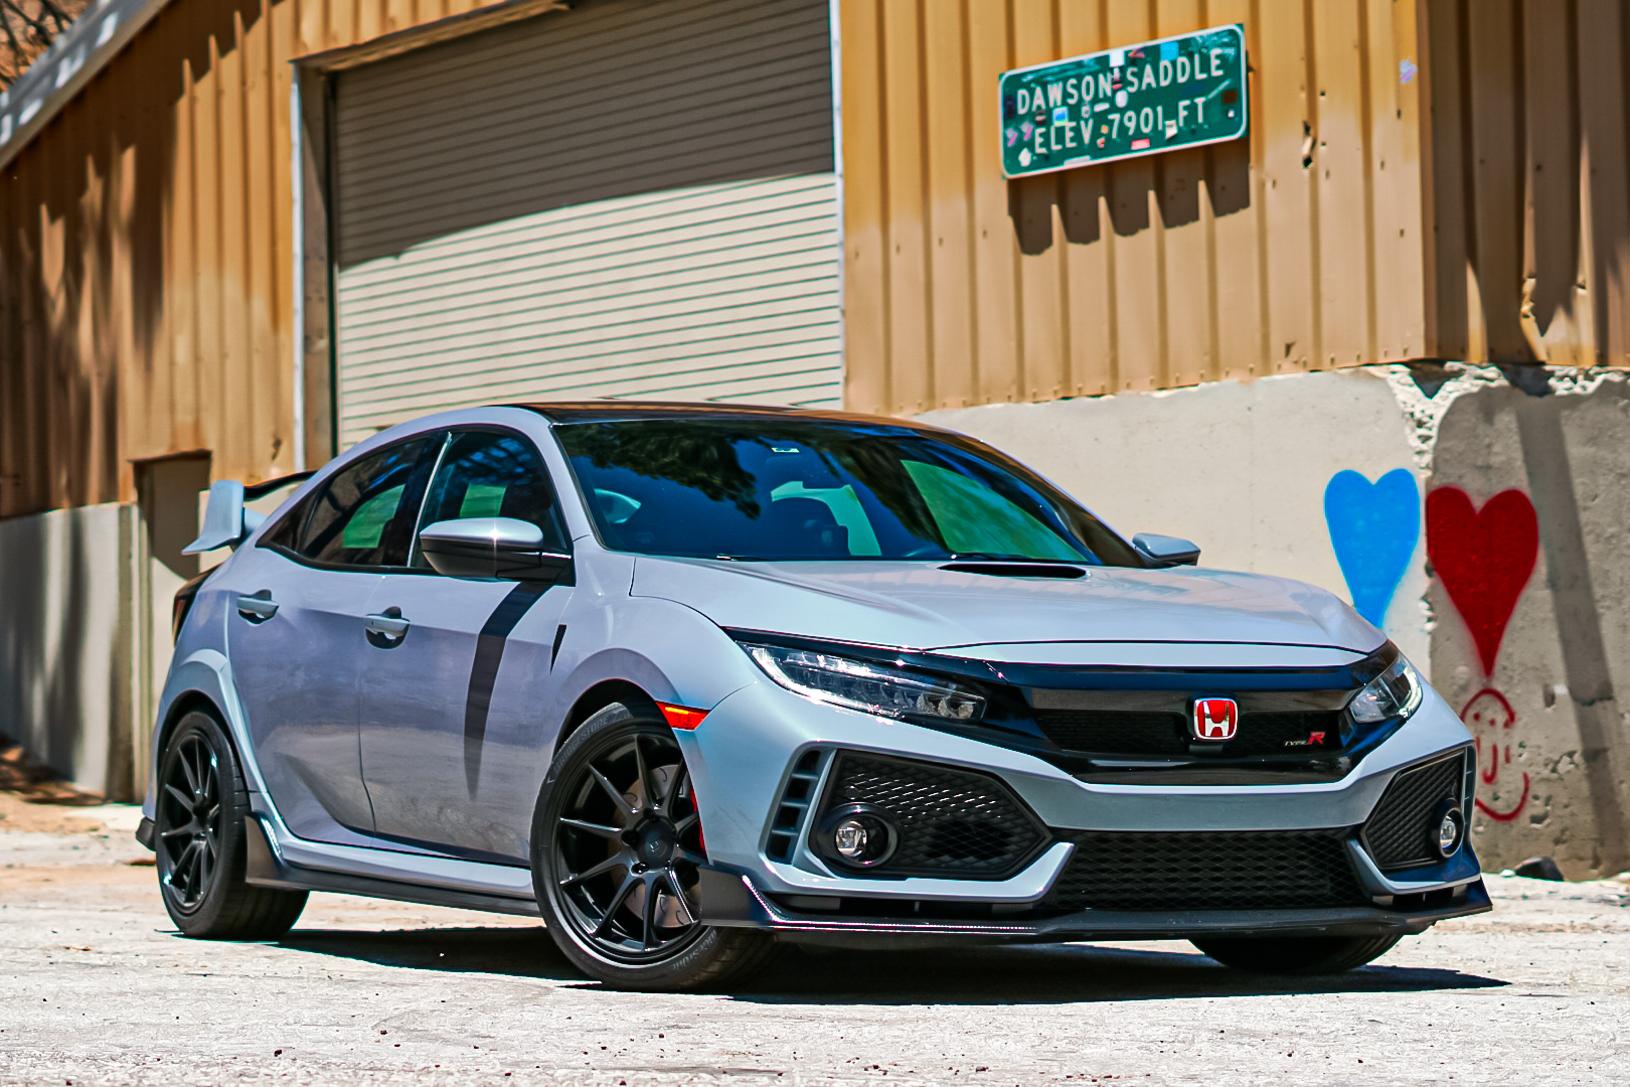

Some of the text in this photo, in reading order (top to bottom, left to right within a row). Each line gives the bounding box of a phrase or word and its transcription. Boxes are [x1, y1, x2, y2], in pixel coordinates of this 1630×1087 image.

[1016, 48, 1224, 115] DAWSON SADDLE
[1035, 96, 1207, 154] ELEV 7901 FT
